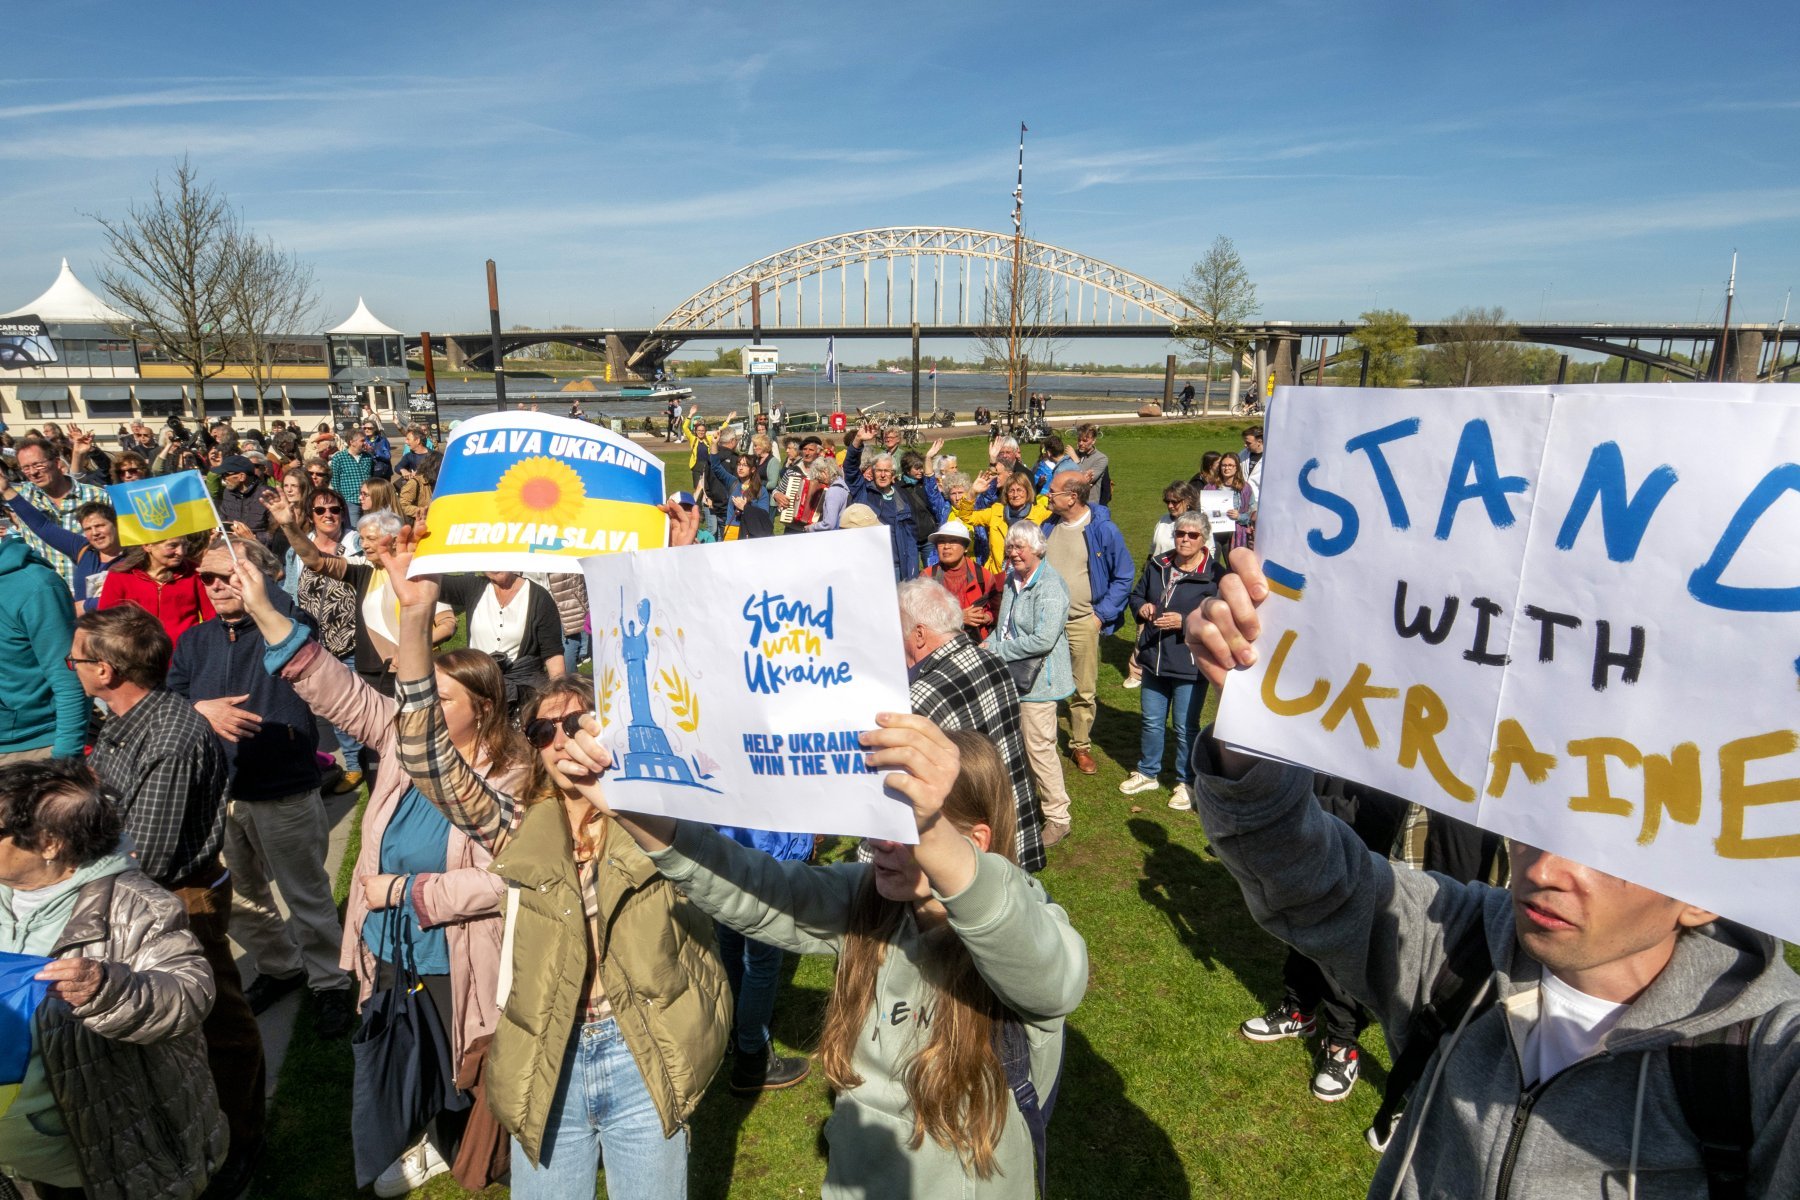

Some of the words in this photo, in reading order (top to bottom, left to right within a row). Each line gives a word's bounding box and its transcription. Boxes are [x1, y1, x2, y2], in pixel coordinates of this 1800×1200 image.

[463, 431, 541, 456] SLAVA
[549, 434, 648, 476] UKRAINI
[446, 522, 558, 546] HEROYAM
[561, 526, 639, 551] SLAVA
[743, 586, 834, 648] Stand
[1394, 579, 1645, 691] WITH
[763, 623, 821, 658] with
[744, 651, 852, 694] Ukraine
[743, 733, 784, 753] HELP
[789, 731, 872, 753] UKRAIN
[1261, 630, 1800, 859] UKRAINE
[749, 755, 785, 775] WIN
[789, 754, 827, 775] THE
